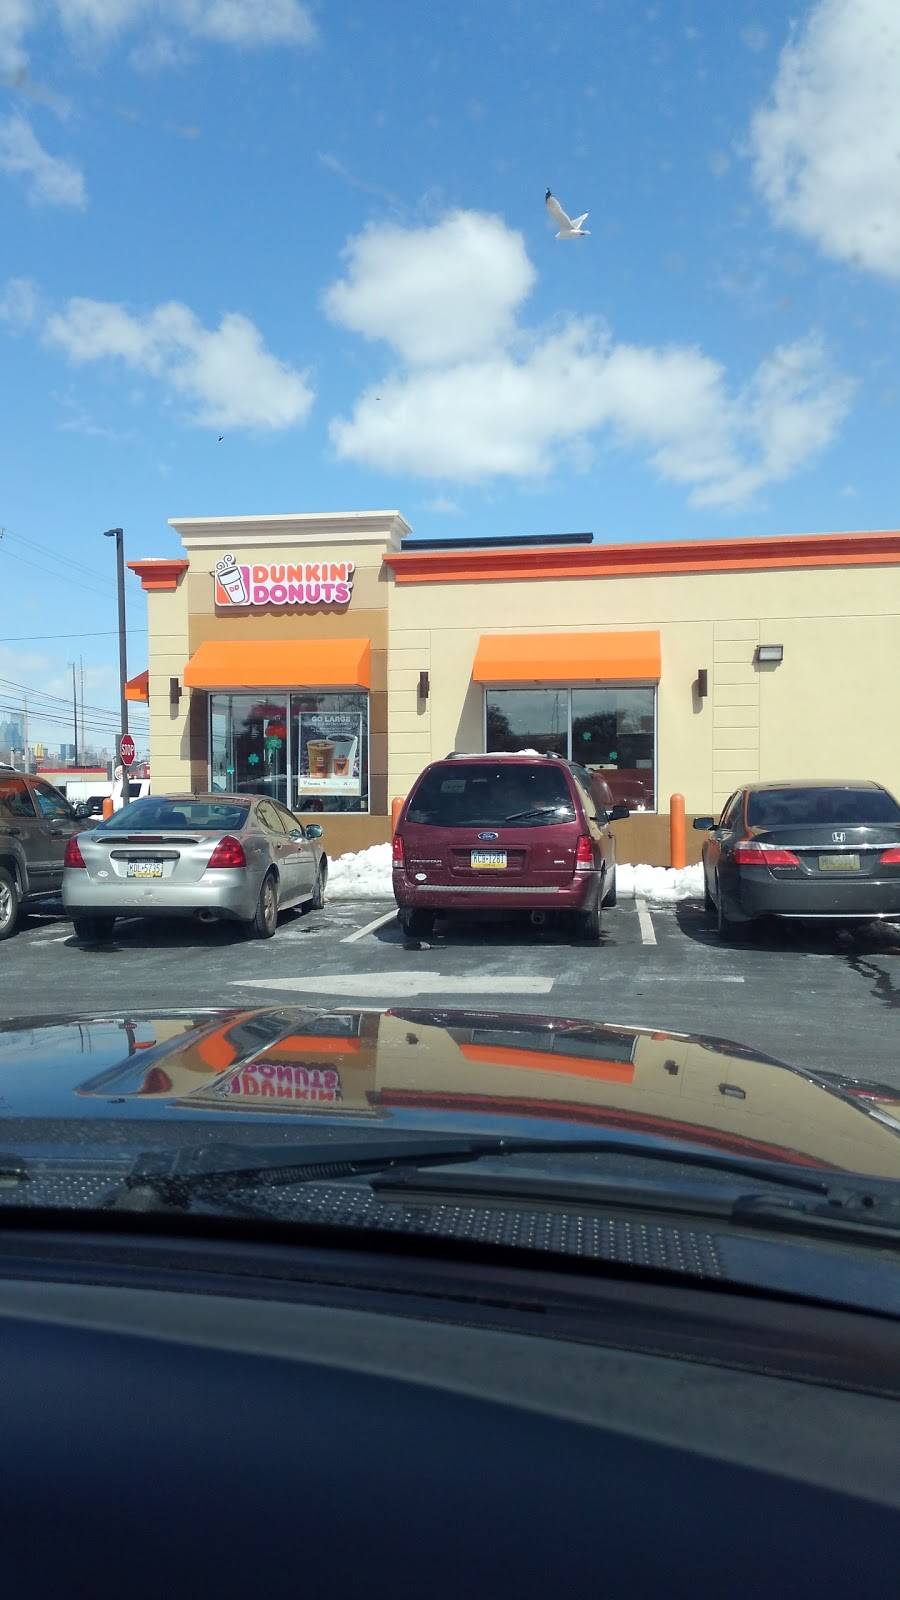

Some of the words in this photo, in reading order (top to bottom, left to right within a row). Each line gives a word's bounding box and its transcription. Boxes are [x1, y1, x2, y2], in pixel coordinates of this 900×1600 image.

[252, 563, 353, 583] DUNKIN'
[253, 583, 349, 603] DONUTS
[324, 715, 351, 723] LARGE
[121, 743, 135, 756] STOP
